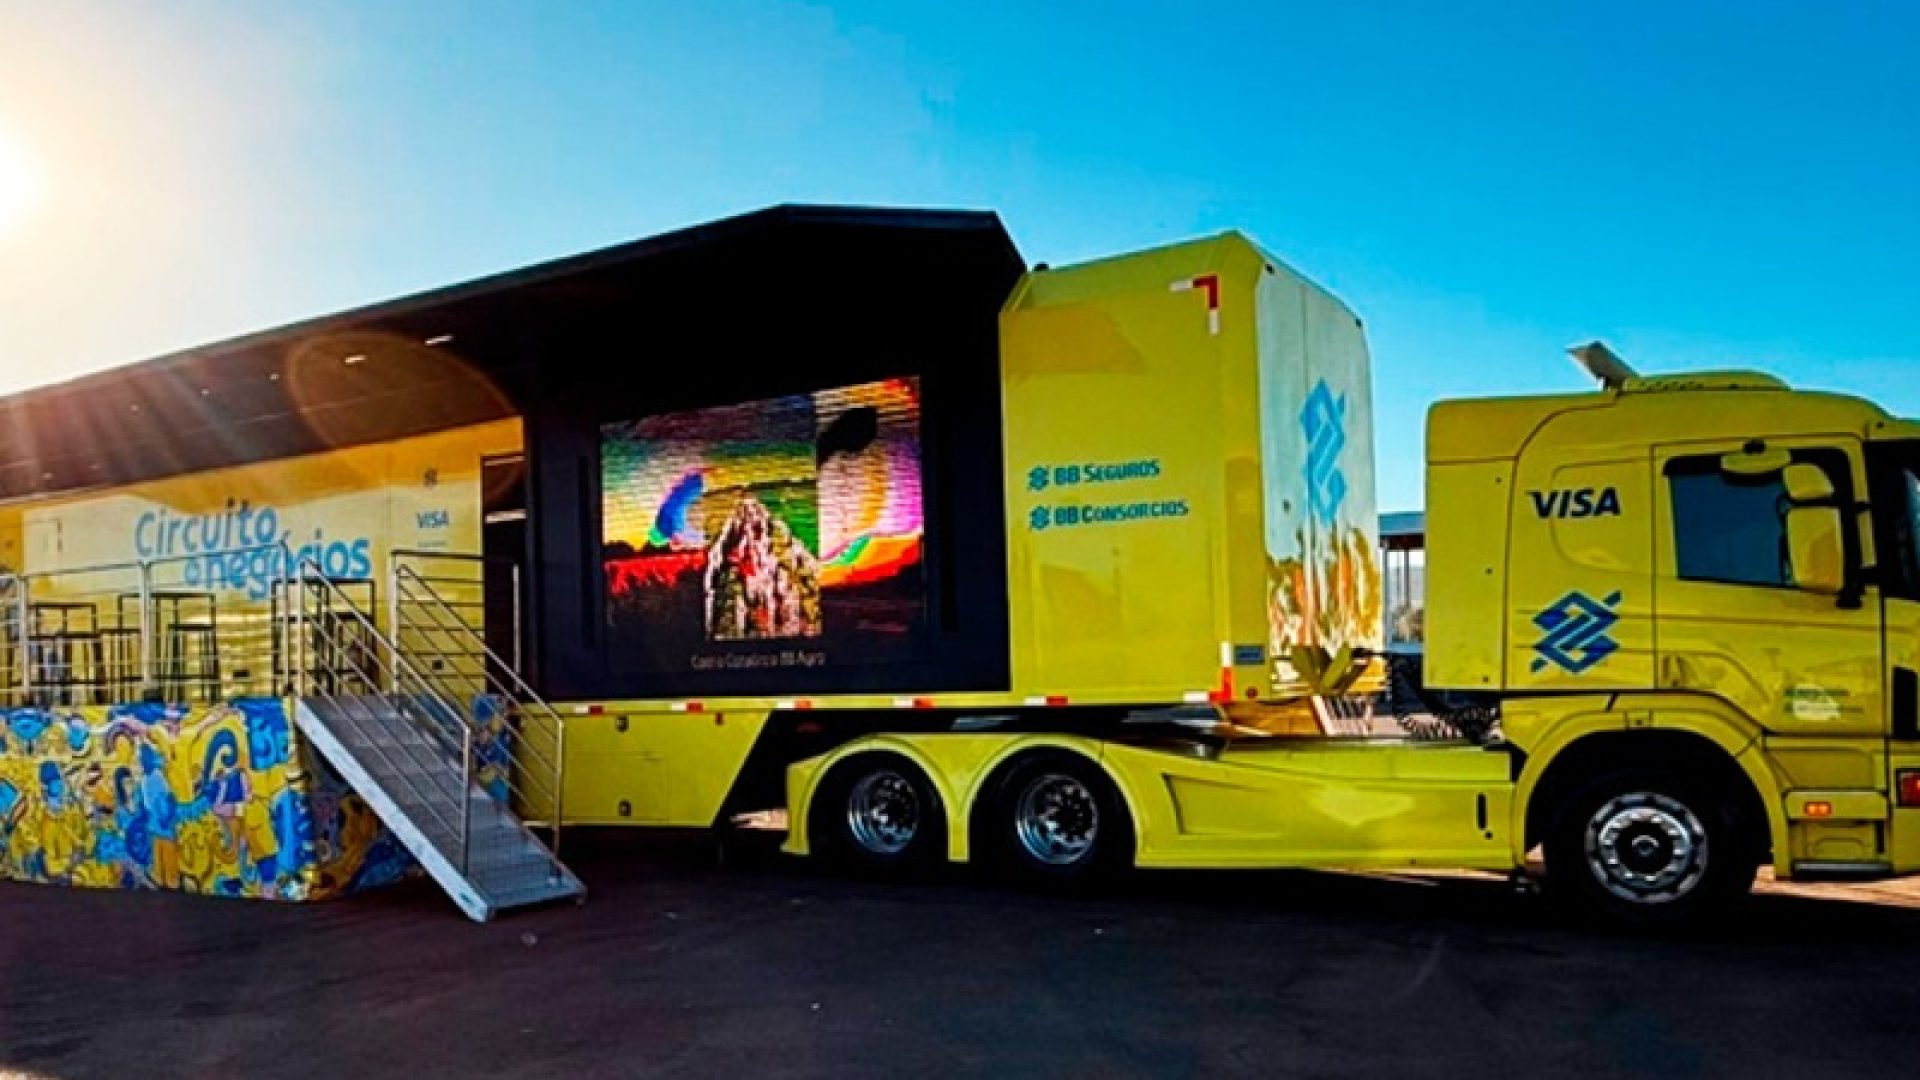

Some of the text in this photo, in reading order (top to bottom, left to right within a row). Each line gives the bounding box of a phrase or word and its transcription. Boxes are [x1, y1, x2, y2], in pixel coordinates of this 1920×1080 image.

[1055, 465, 1080, 485] BB
[1526, 487, 1621, 519] VISA
[416, 510, 449, 529] VISA
[1055, 506, 1079, 525] BB
[136, 497, 278, 558] Circuito
